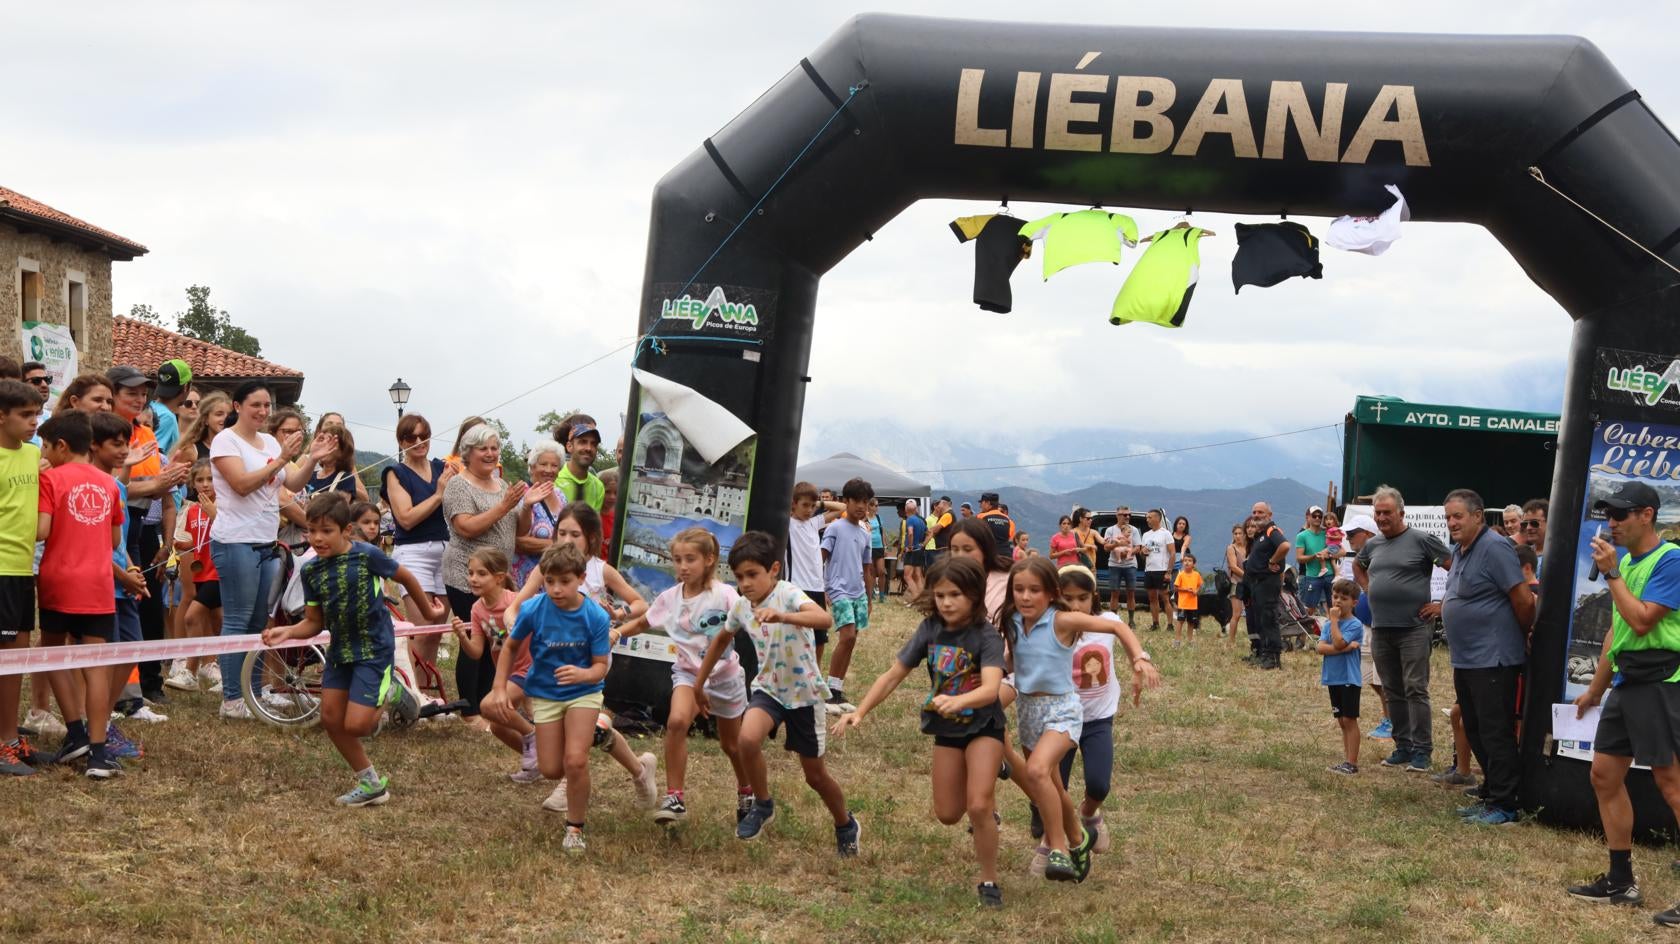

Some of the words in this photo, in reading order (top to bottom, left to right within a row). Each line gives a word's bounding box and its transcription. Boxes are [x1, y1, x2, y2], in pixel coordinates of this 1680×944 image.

[954, 51, 1431, 167] LIÉBANA
[662, 286, 759, 330] LIÉBANA
[1405, 412, 1452, 426] AYTO.
[1459, 415, 1480, 428] DE
[1603, 423, 1680, 449] Cabez
[80, 493, 102, 509] XL
